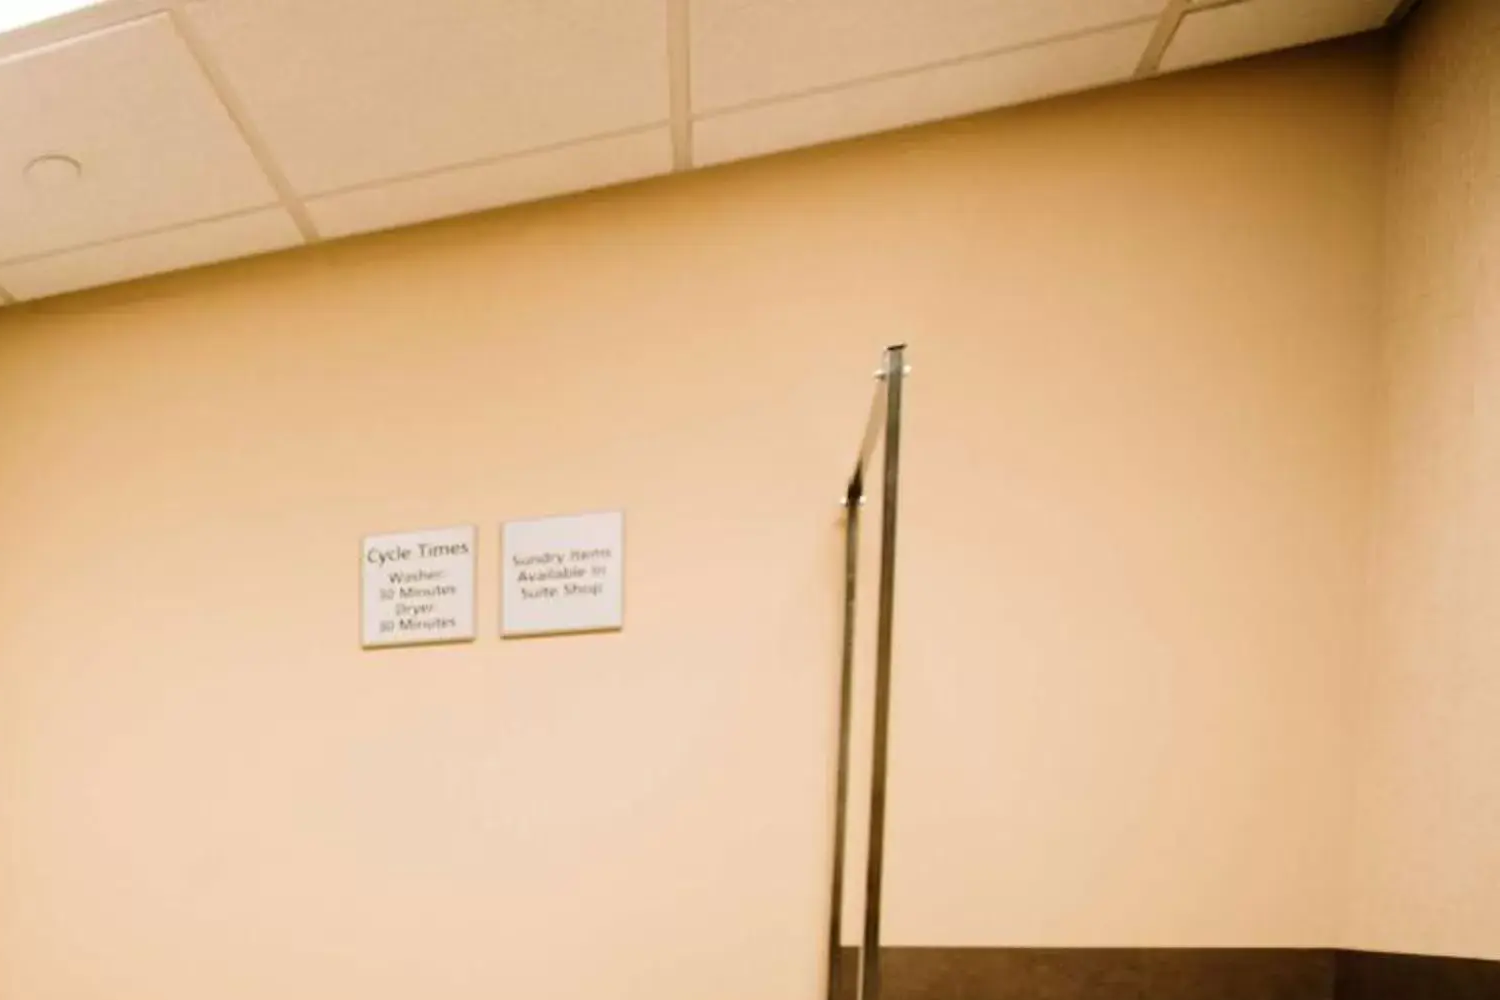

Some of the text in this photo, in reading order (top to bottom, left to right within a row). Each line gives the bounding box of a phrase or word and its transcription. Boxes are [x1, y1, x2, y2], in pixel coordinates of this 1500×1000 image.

[366, 543, 469, 567] Cycle Times
[512, 553, 564, 566] Sundry
[518, 567, 585, 582] Available
[399, 586, 456, 599] Minutes
[399, 618, 456, 631] Minutes
